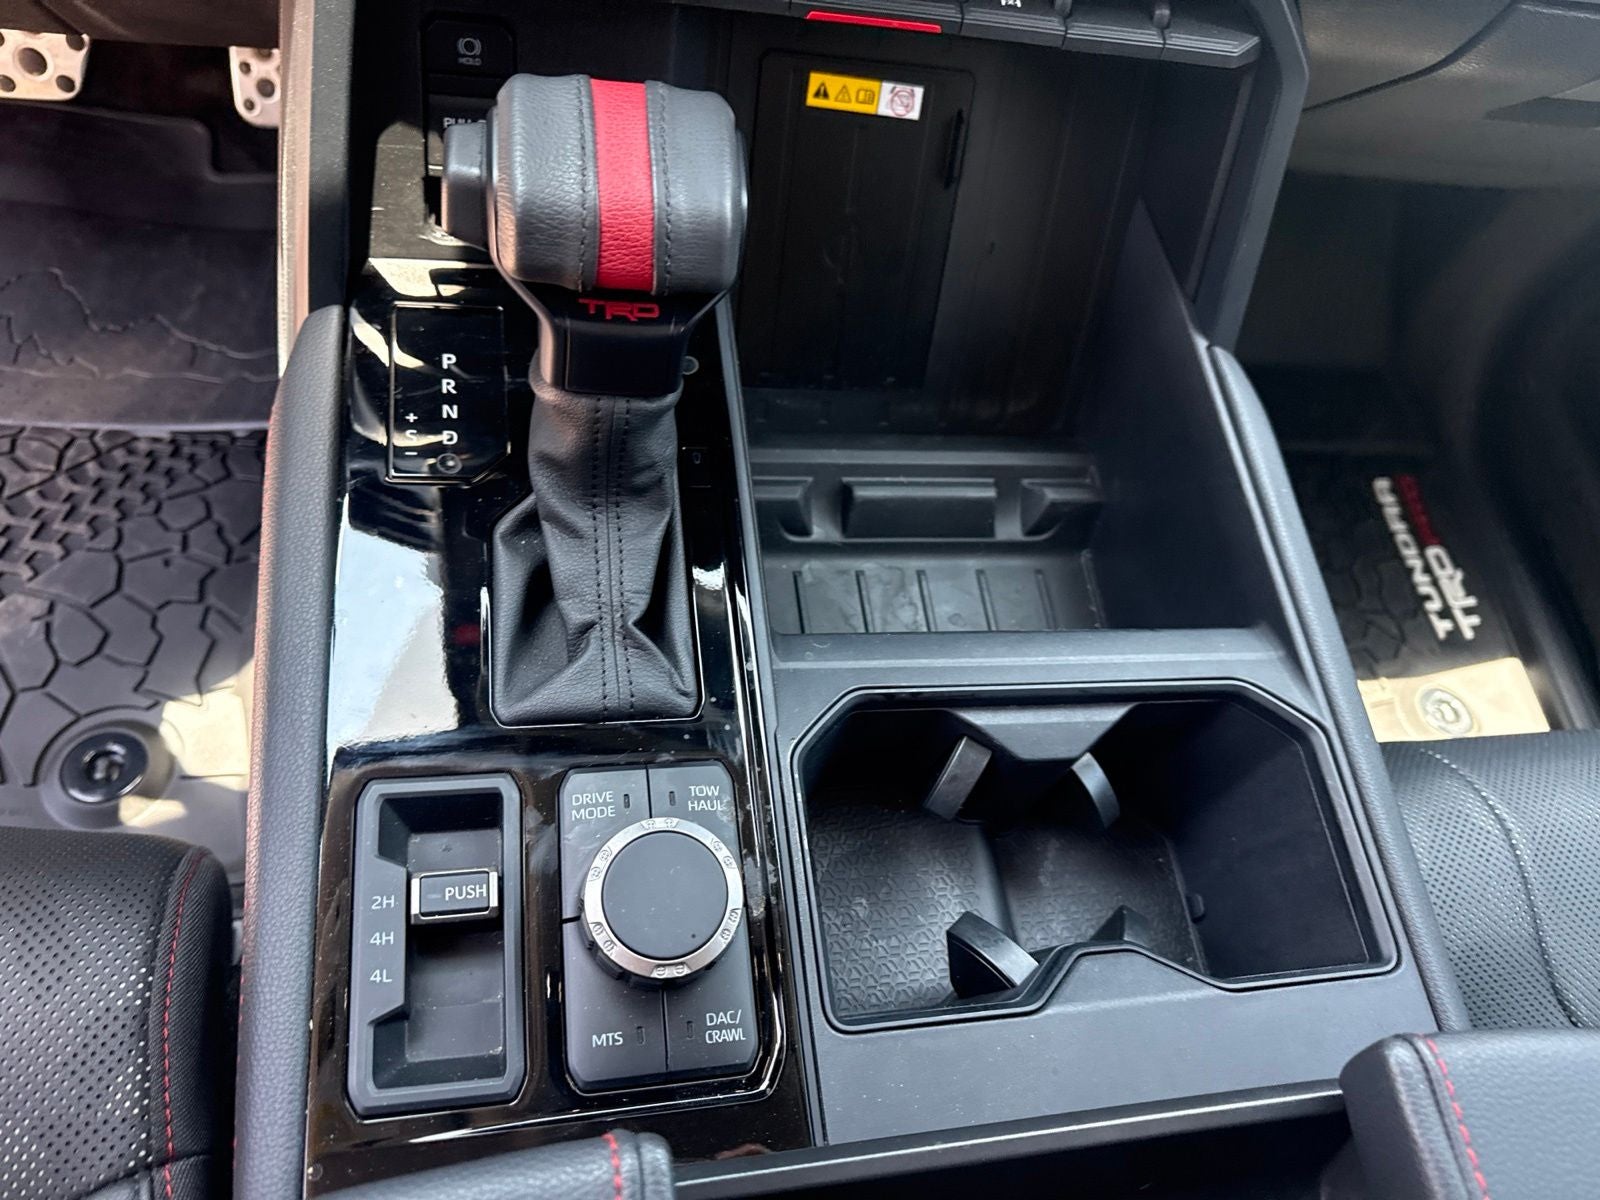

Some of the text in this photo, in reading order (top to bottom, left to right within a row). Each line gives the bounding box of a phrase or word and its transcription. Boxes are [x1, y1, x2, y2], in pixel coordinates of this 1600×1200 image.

[578, 298, 659, 321] TRD
[441, 353, 457, 370] P
[441, 378, 458, 395] R
[442, 404, 459, 419] N
[405, 429, 417, 442] S
[442, 430, 459, 445] D
[1424, 544, 1482, 640] TRD
[571, 791, 615, 807] DRIVE
[688, 784, 721, 798] TOW
[571, 805, 617, 821] MODE
[687, 799, 725, 812] HAUL
[444, 884, 488, 901] PUSH
[371, 894, 396, 910] 2H
[369, 930, 395, 946] 4H
[369, 967, 393, 983] 4L
[705, 1010, 742, 1027] DAC/
[592, 1030, 624, 1047] MTS
[704, 1026, 747, 1044] CRAWL
